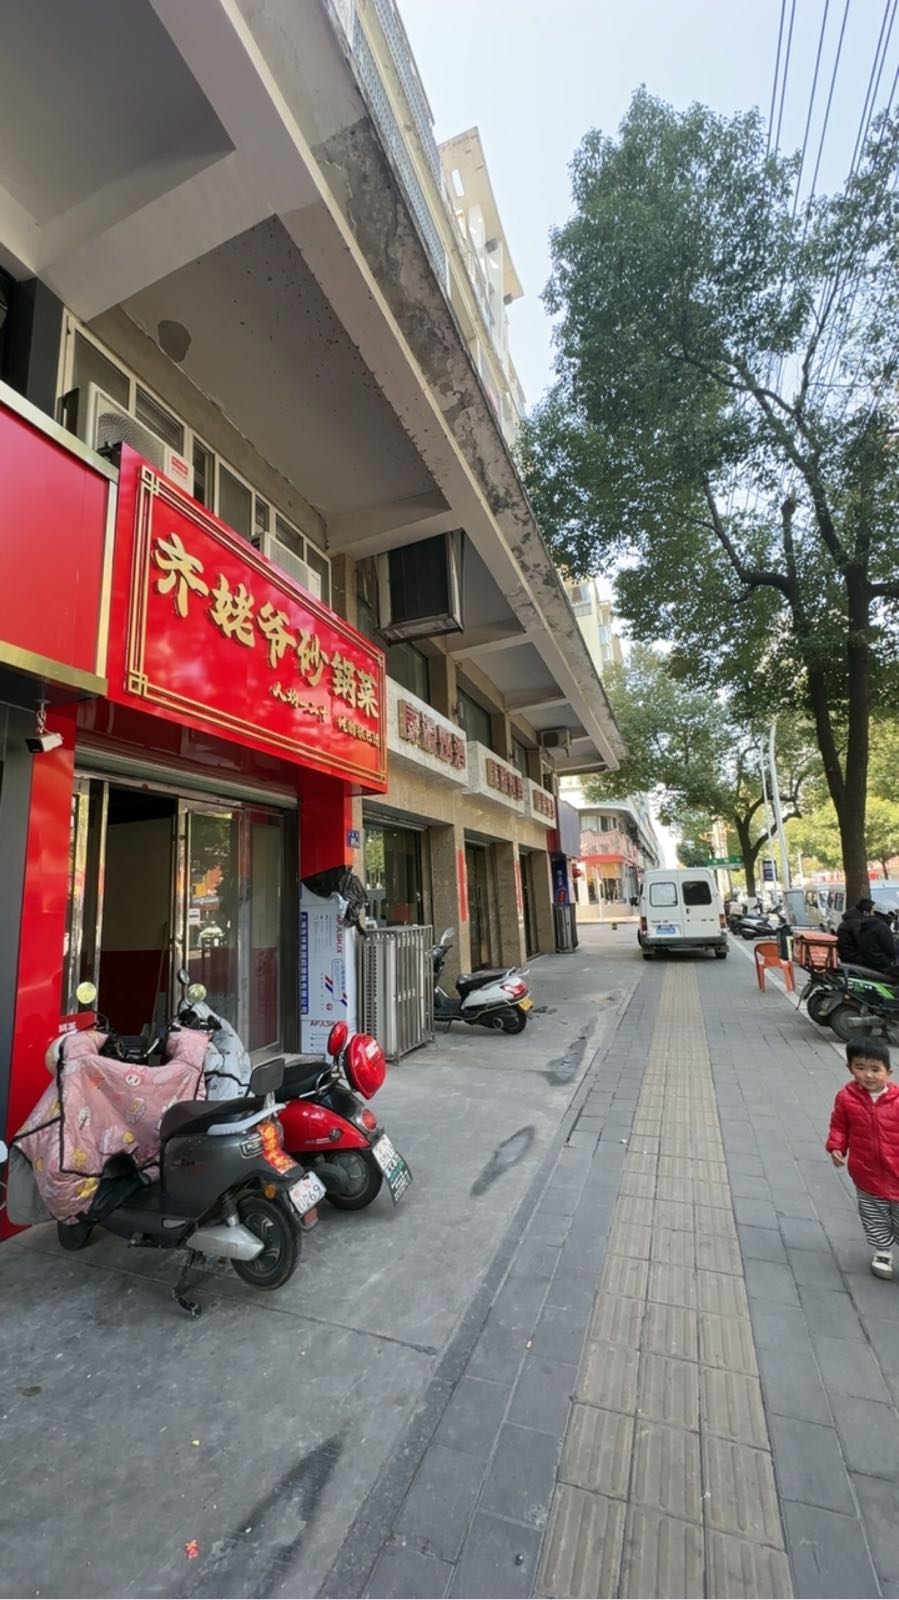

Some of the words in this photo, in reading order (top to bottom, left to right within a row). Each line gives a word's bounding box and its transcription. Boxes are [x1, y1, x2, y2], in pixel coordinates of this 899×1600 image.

[154, 532, 379, 718] 齐姥爷砂锅菜
